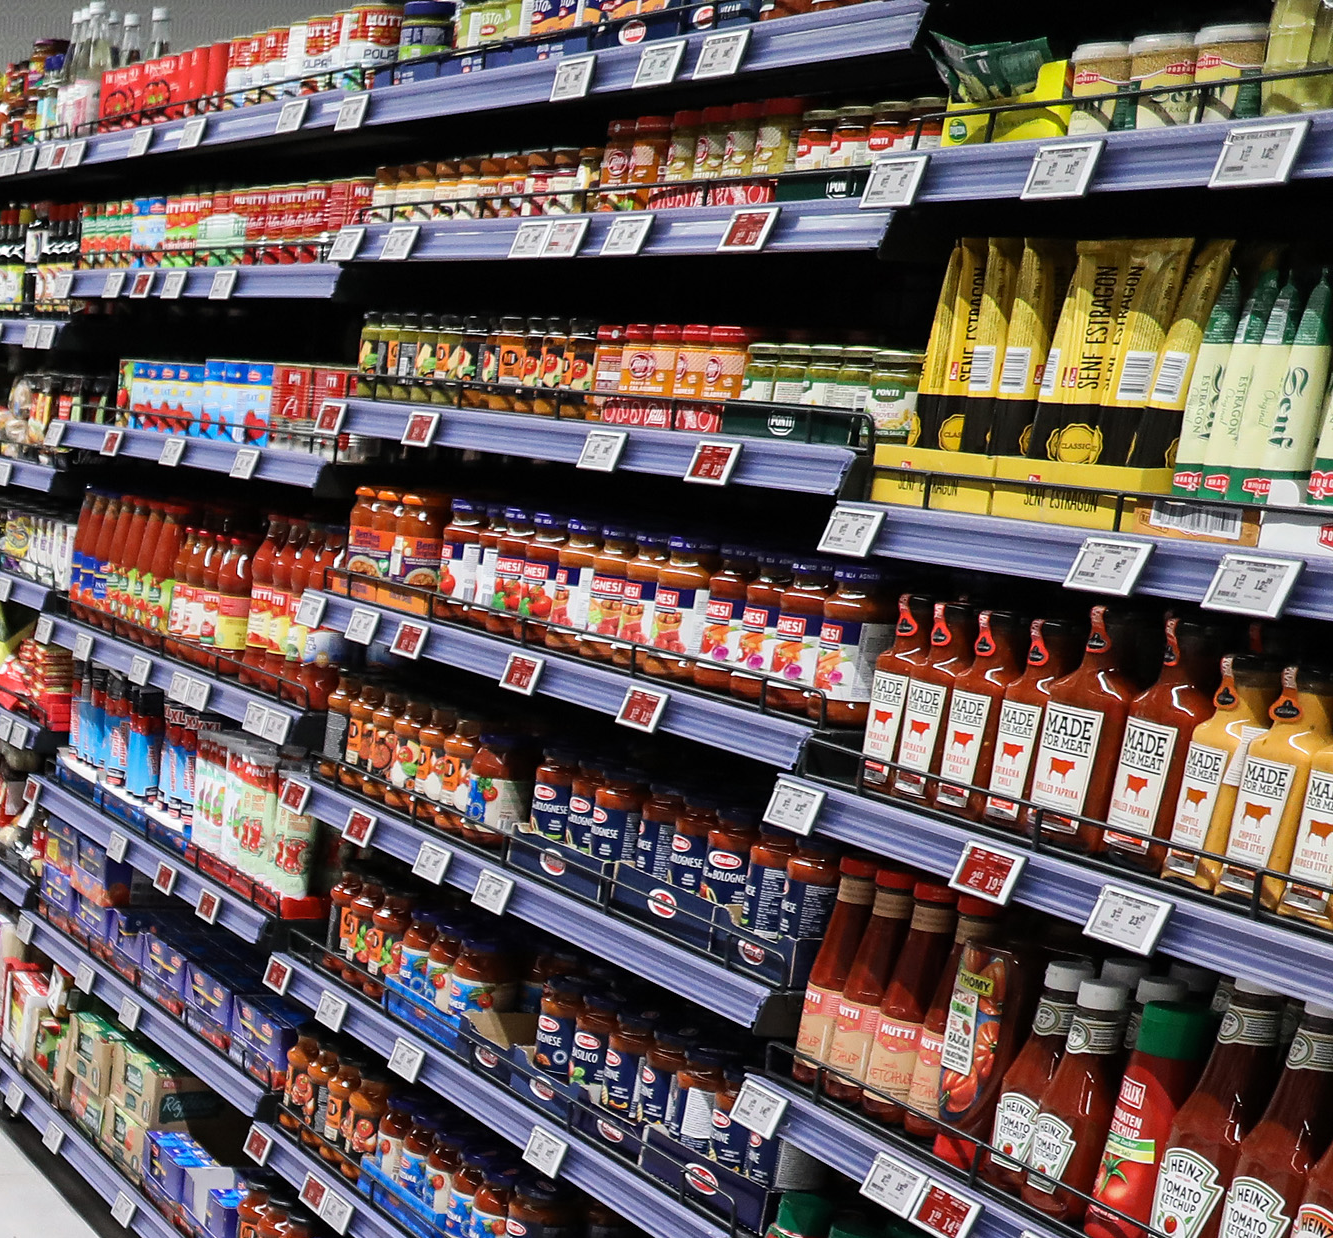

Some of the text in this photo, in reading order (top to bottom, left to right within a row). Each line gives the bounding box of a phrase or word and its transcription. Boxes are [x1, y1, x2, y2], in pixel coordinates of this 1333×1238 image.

[1078, 265, 1118, 390] SENF ESTRAGON
[876, 388, 900, 398] PONTI
[524, 564, 546, 578] GNESI
[874, 677, 903, 695] MADE
[909, 686, 940, 707] MADE
[872, 691, 902, 706] FOR MEAT
[908, 701, 939, 715] FOR MEAT
[952, 696, 985, 717] MADE
[951, 711, 983, 725] FOR MEAT
[1001, 706, 1034, 727] MADE
[1047, 712, 1094, 740] MADE
[1000, 722, 1033, 737] FOR MEAT
[1043, 733, 1092, 754] FOR MEAT
[1127, 729, 1167, 757] MADE
[1123, 749, 1165, 772] FOR MEAT
[1188, 751, 1222, 772] MADE
[1186, 765, 1219, 782] FOR MEAT
[1245, 763, 1288, 787] MADE
[1243, 781, 1285, 797] FOR MEAT
[713, 855, 740, 867] Barilla
[960, 972, 991, 991] THOMY
[881, 1022, 916, 1040] MUTTI
[1120, 1080, 1143, 1105] FELIX
[1006, 1101, 1031, 1116] HEINZ
[1000, 1113, 1030, 1132] TOMATO
[1000, 1125, 1027, 1141] KETCHUP
[1170, 1157, 1204, 1183] HEINZ
[1164, 1177, 1202, 1203] TOMATO
[1237, 1187, 1270, 1211] HEINZ
[1161, 1193, 1197, 1214] KETCHUP
[1229, 1208, 1267, 1234] TOMATO
